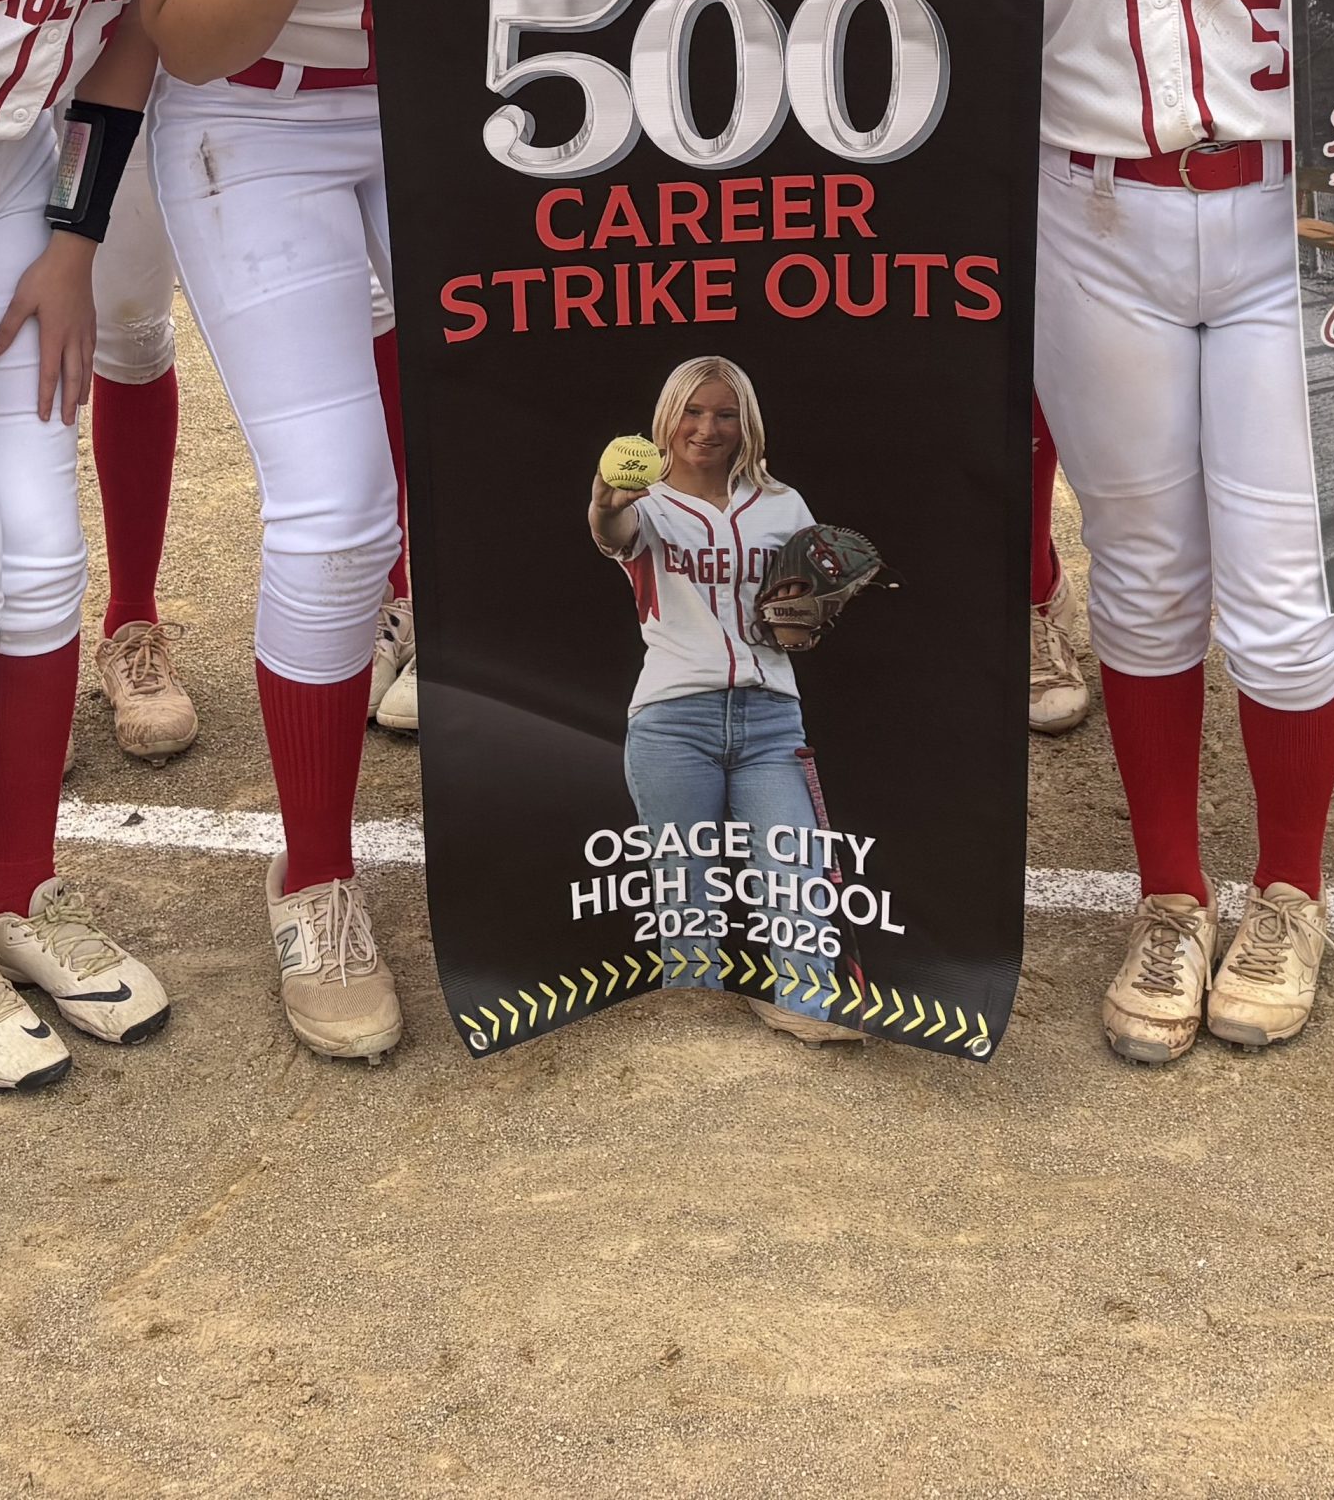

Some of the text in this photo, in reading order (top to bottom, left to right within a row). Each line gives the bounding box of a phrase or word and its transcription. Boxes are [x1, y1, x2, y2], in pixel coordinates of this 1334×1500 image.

[535, 173, 877, 251] CAREER
[440, 253, 1002, 345] STRIKE OUTS
[584, 821, 876, 876] OSAGE CITY
[570, 867, 906, 934] HIGH SCHOOL
[634, 908, 841, 958] 2023-2026
